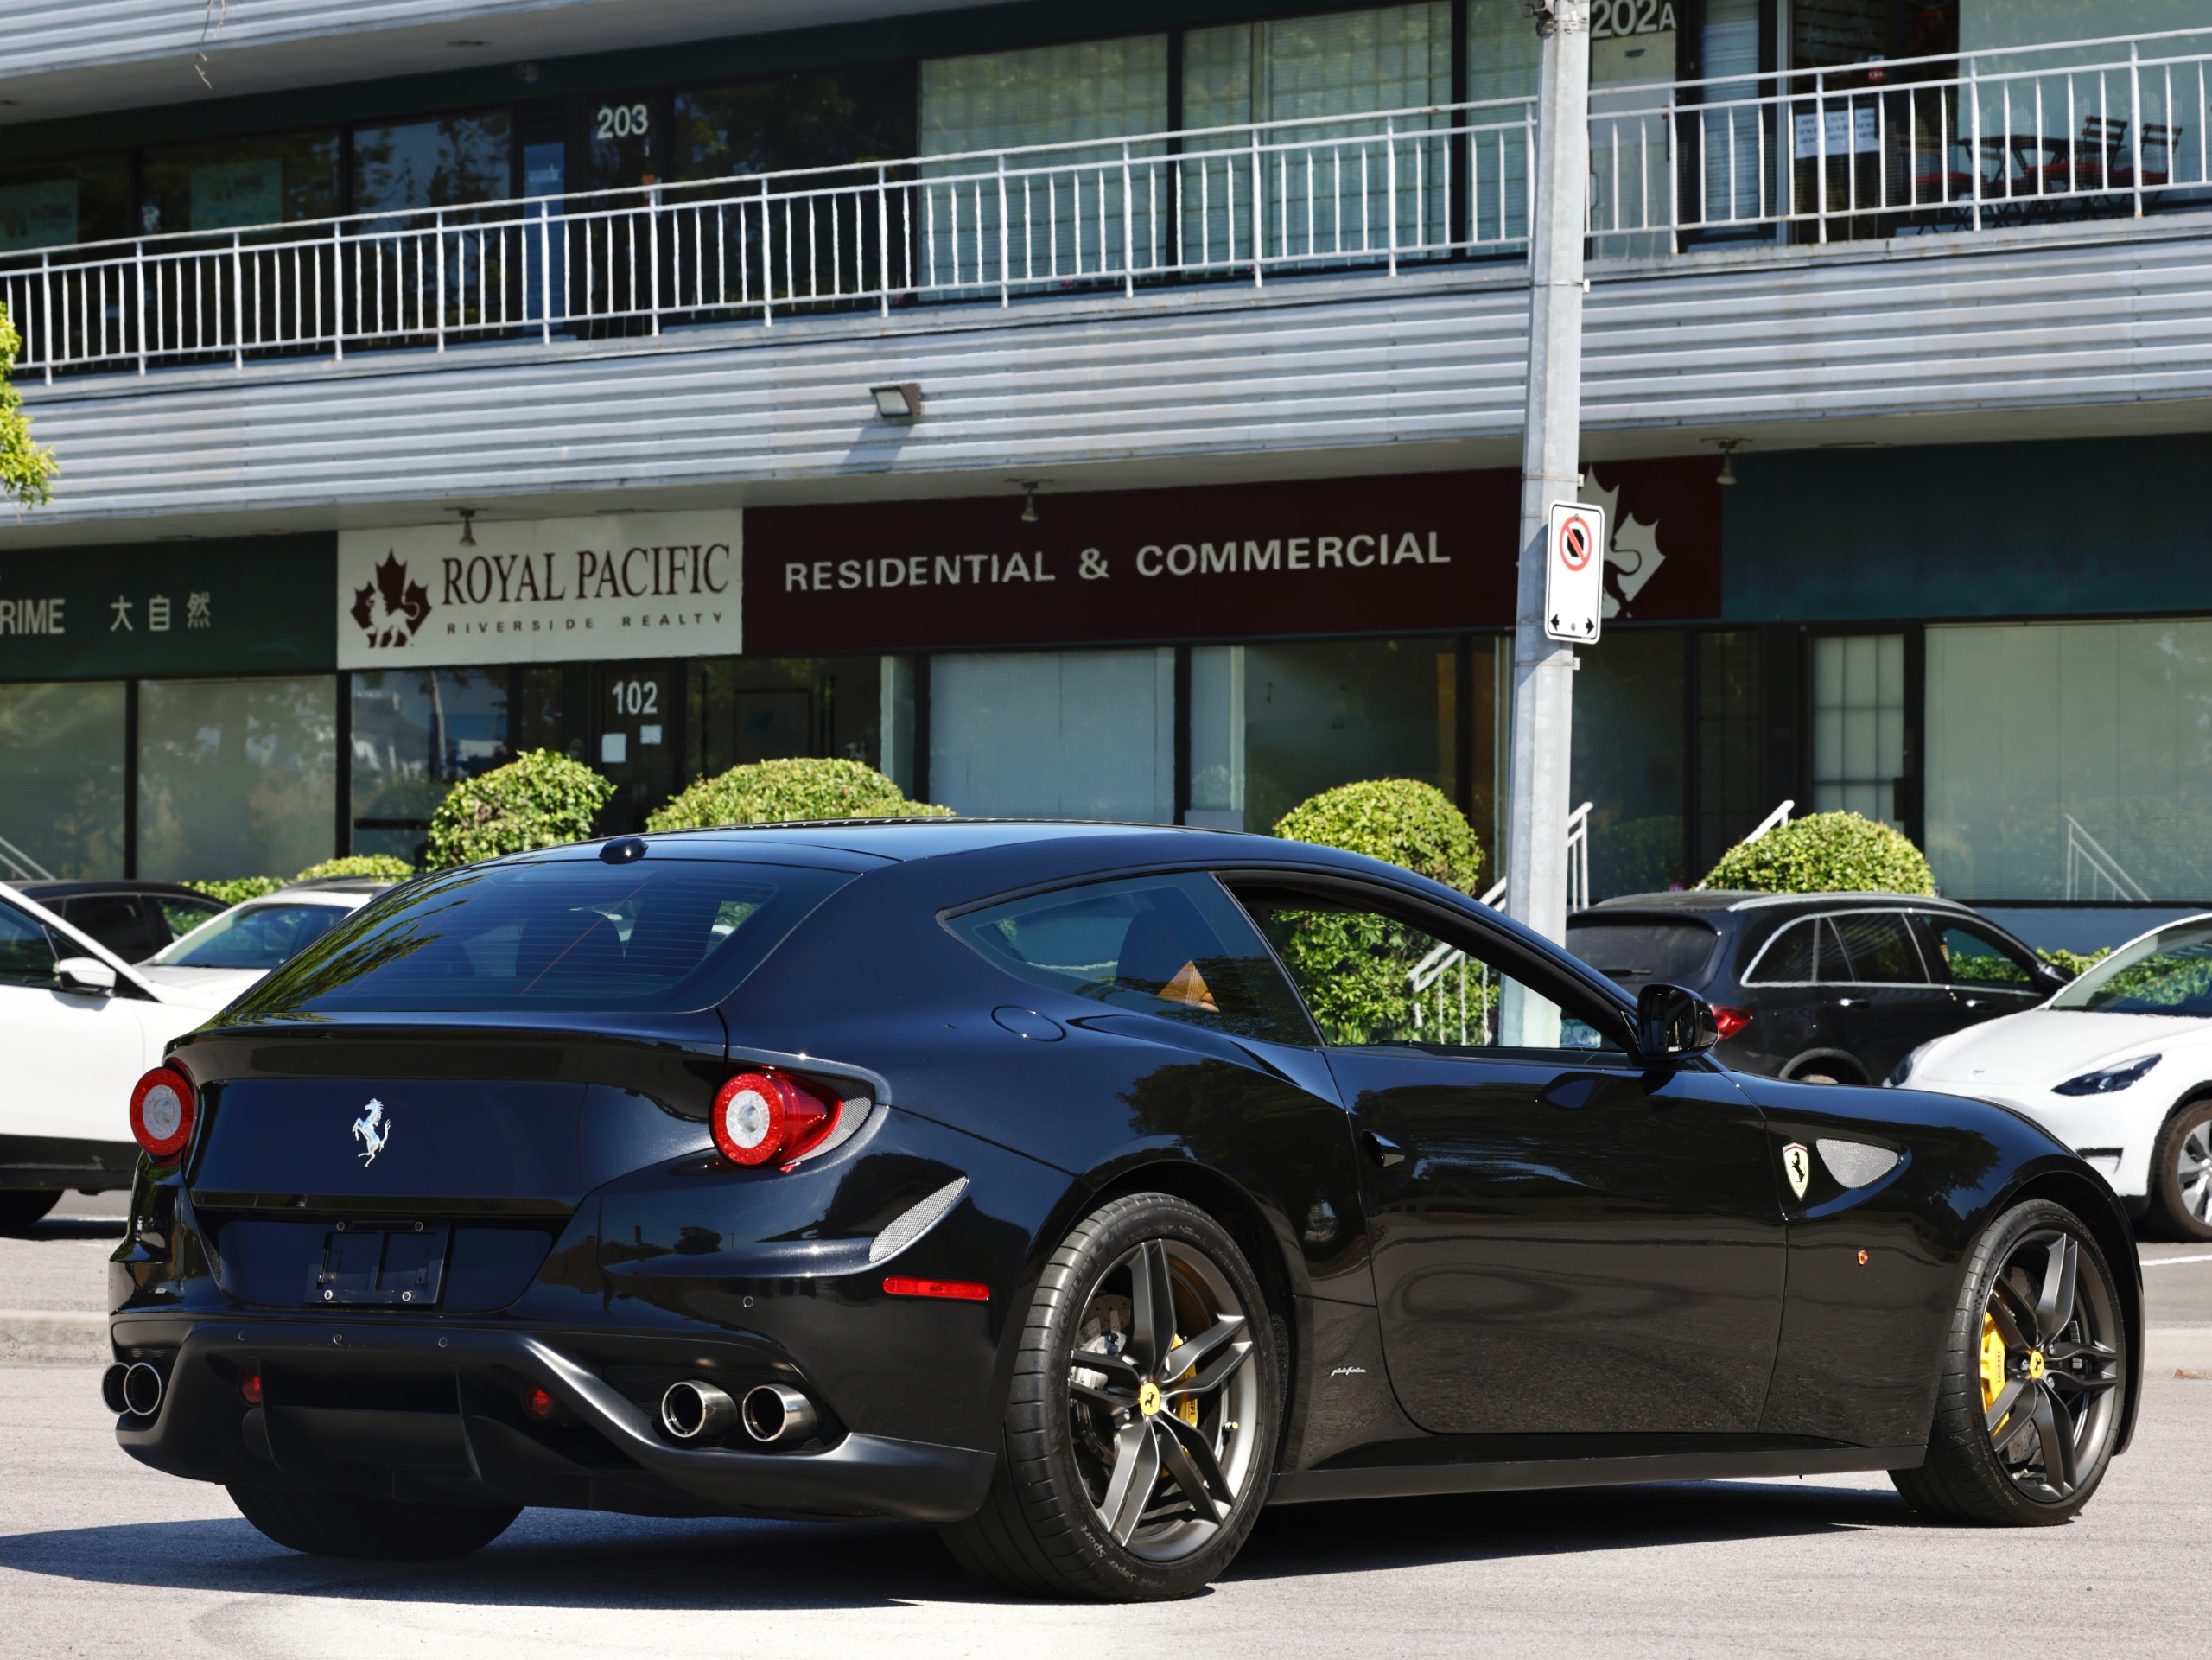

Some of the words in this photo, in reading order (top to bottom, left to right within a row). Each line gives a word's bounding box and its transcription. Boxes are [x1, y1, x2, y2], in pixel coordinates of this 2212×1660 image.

[1591, 0, 1677, 38] 202A
[596, 104, 648, 139] 203
[442, 553, 566, 605] ROYAL
[575, 544, 730, 600] PACIFIC
[785, 551, 1056, 592] RESIDENTIAL
[1078, 548, 1110, 580] &
[1135, 531, 1452, 576] COMMERCIAL
[110, 592, 211, 632] 大自然
[447, 618, 594, 635] RIVERSIDE
[622, 612, 724, 628] REALTY
[612, 680, 658, 715] 102
[1080, 1524, 1107, 1558] Sport
[1108, 1559, 1138, 1584] Super
